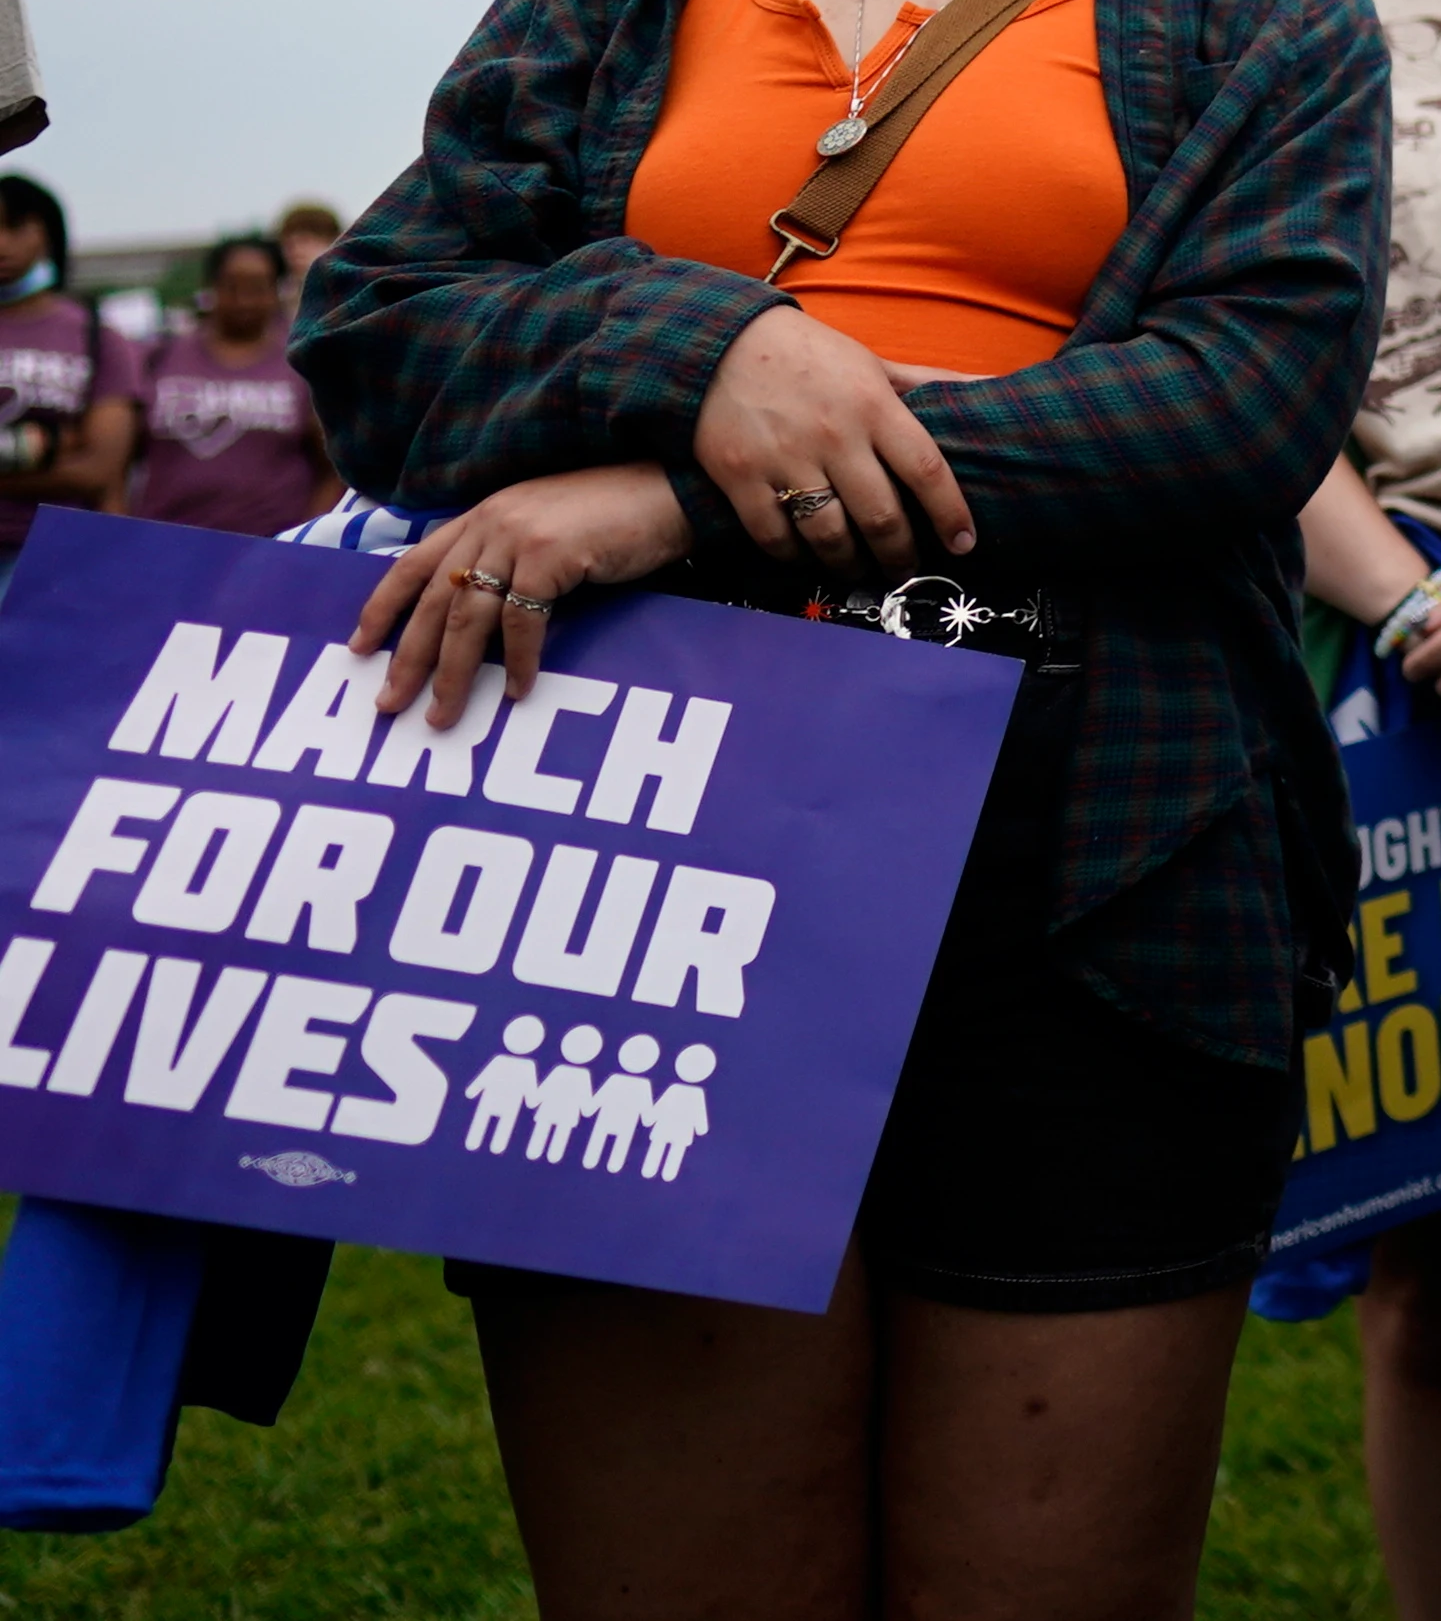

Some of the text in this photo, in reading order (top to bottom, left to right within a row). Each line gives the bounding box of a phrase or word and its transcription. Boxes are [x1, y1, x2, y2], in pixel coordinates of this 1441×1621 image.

[108, 622, 732, 835] MARCH
[30, 776, 776, 1018] FOR OUR
[0, 936, 477, 1146] LIVES
